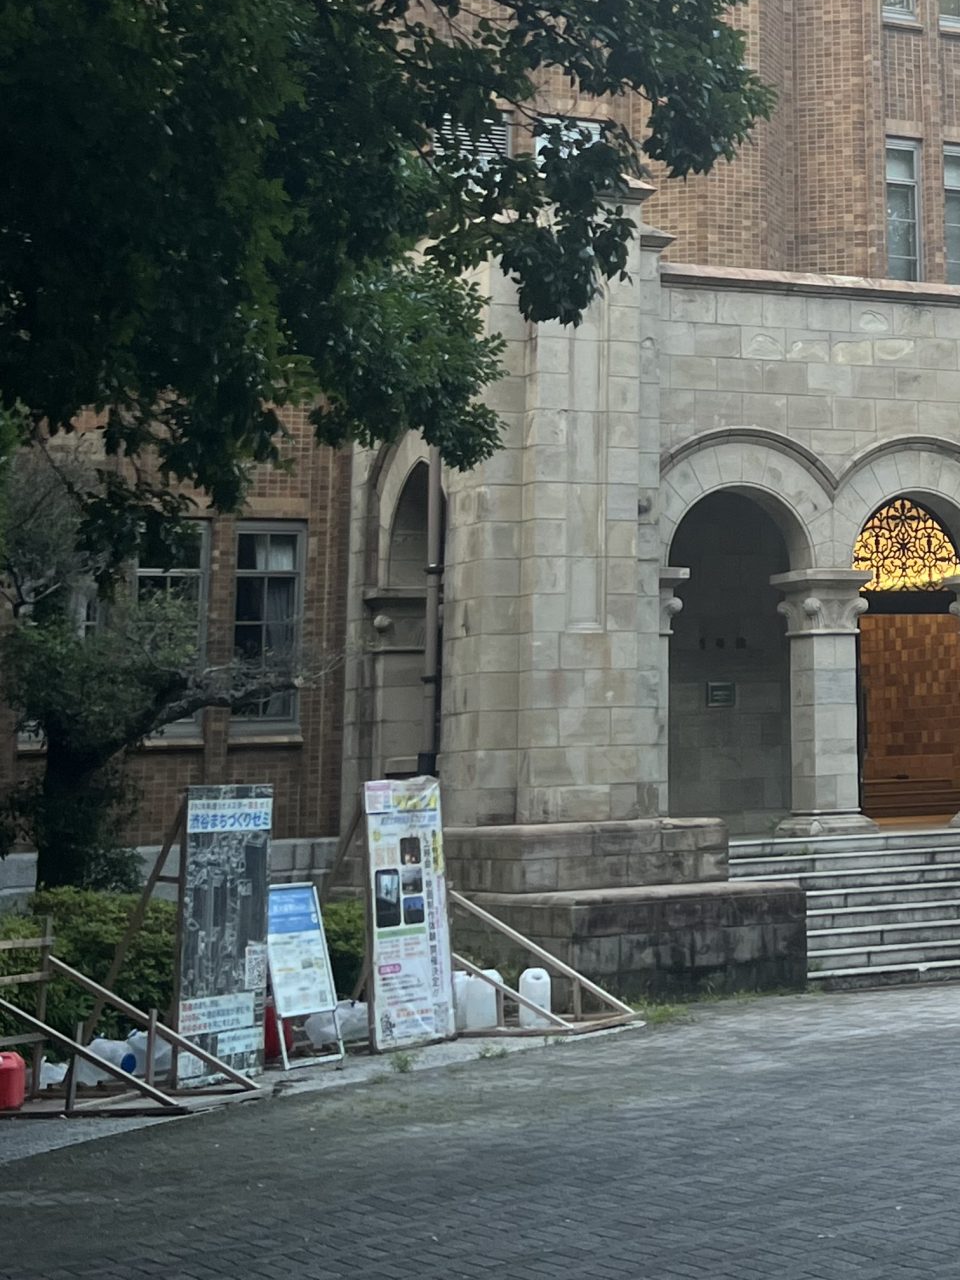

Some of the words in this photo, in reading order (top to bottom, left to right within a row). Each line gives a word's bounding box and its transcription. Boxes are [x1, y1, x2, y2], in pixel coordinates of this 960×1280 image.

[190, 811, 270, 830] 渋谷まちづくりゼミ
